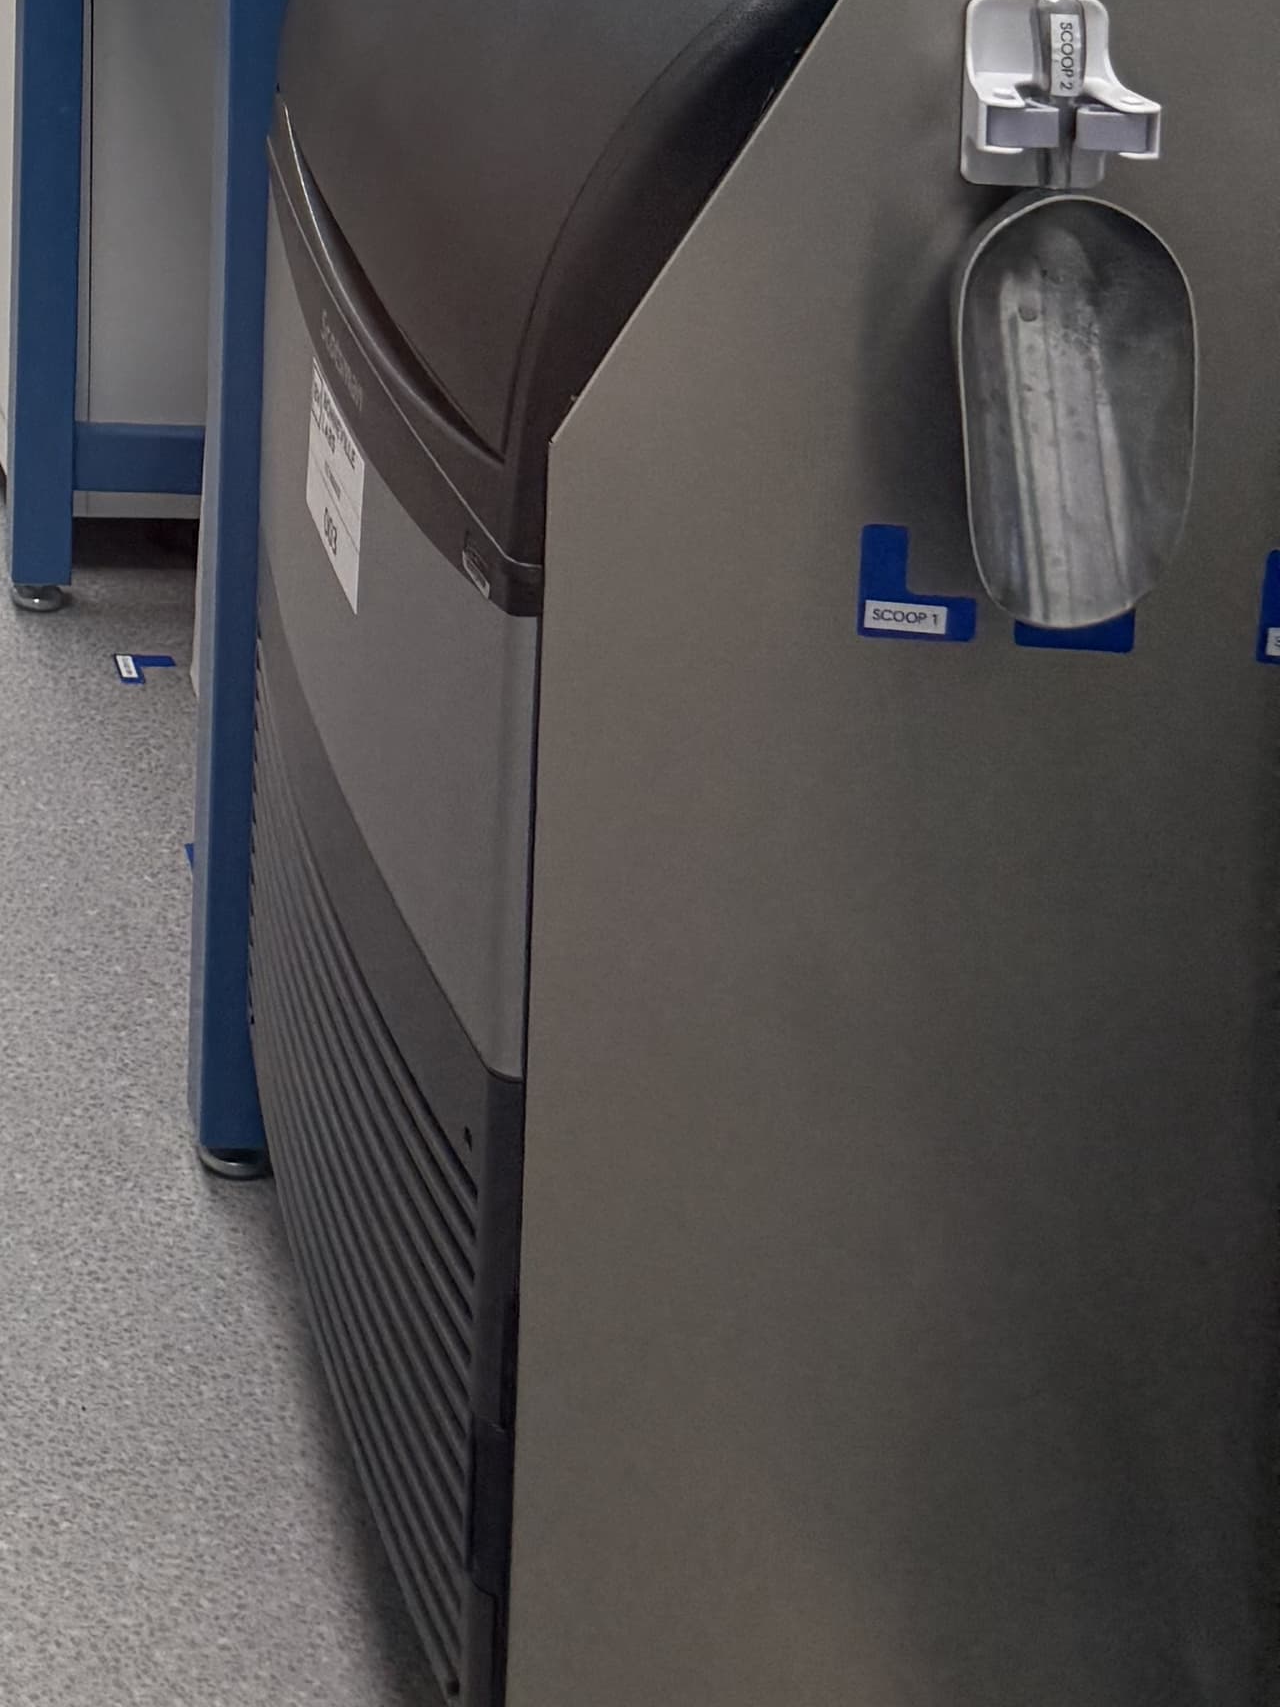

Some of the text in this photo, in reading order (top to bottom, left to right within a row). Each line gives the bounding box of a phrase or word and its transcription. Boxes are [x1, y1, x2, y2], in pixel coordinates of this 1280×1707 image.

[1059, 22, 1074, 91] SCOOP 2
[323, 507, 338, 556] 003
[872, 608, 939, 626] SCOOP 1
